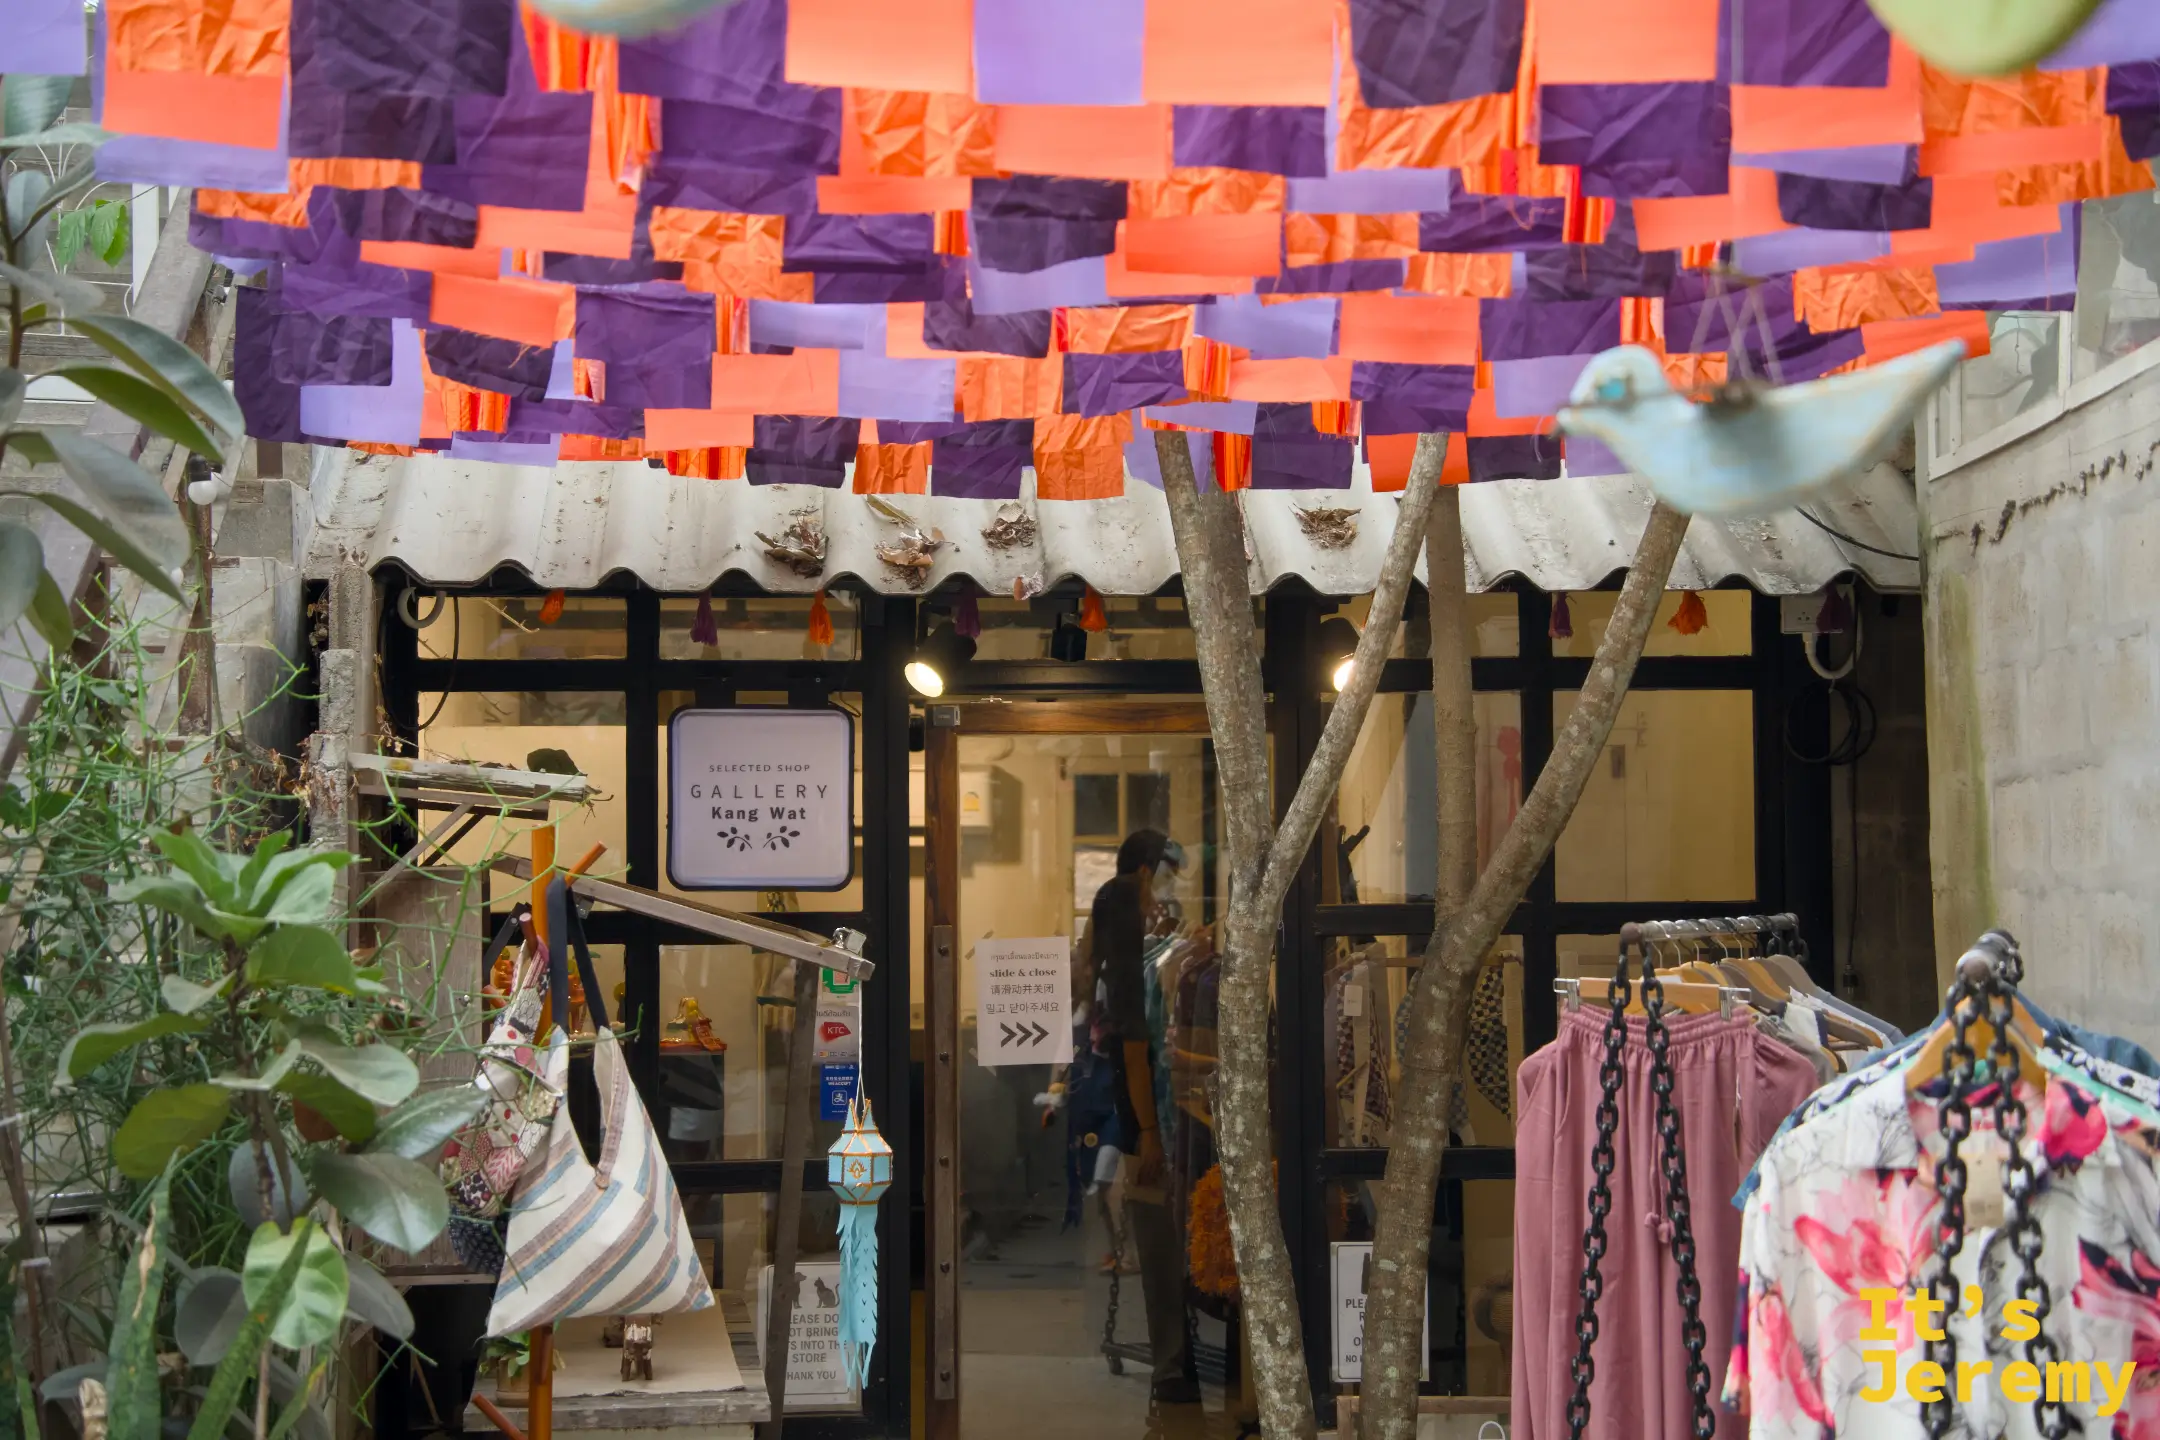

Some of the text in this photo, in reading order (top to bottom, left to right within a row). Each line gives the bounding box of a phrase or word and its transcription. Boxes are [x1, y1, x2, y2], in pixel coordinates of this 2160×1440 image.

[709, 764, 810, 772] SELECTED SHOP
[690, 784, 828, 799] GALLERY
[711, 806, 806, 822] Kang Wat
[989, 968, 1057, 978] slide & close
[990, 983, 1054, 995] 请滑动并关闭
[1009, 1001, 1060, 1014] 닫아주세요
[827, 1026, 845, 1034] KTC
[790, 1313, 840, 1324] EASE DO
[789, 1327, 838, 1337] OT BRING
[800, 1340, 825, 1350] INTO
[792, 1352, 827, 1363] STORE
[1345, 1354, 1358, 1363] NO
[786, 1370, 836, 1381] HANK YOU
